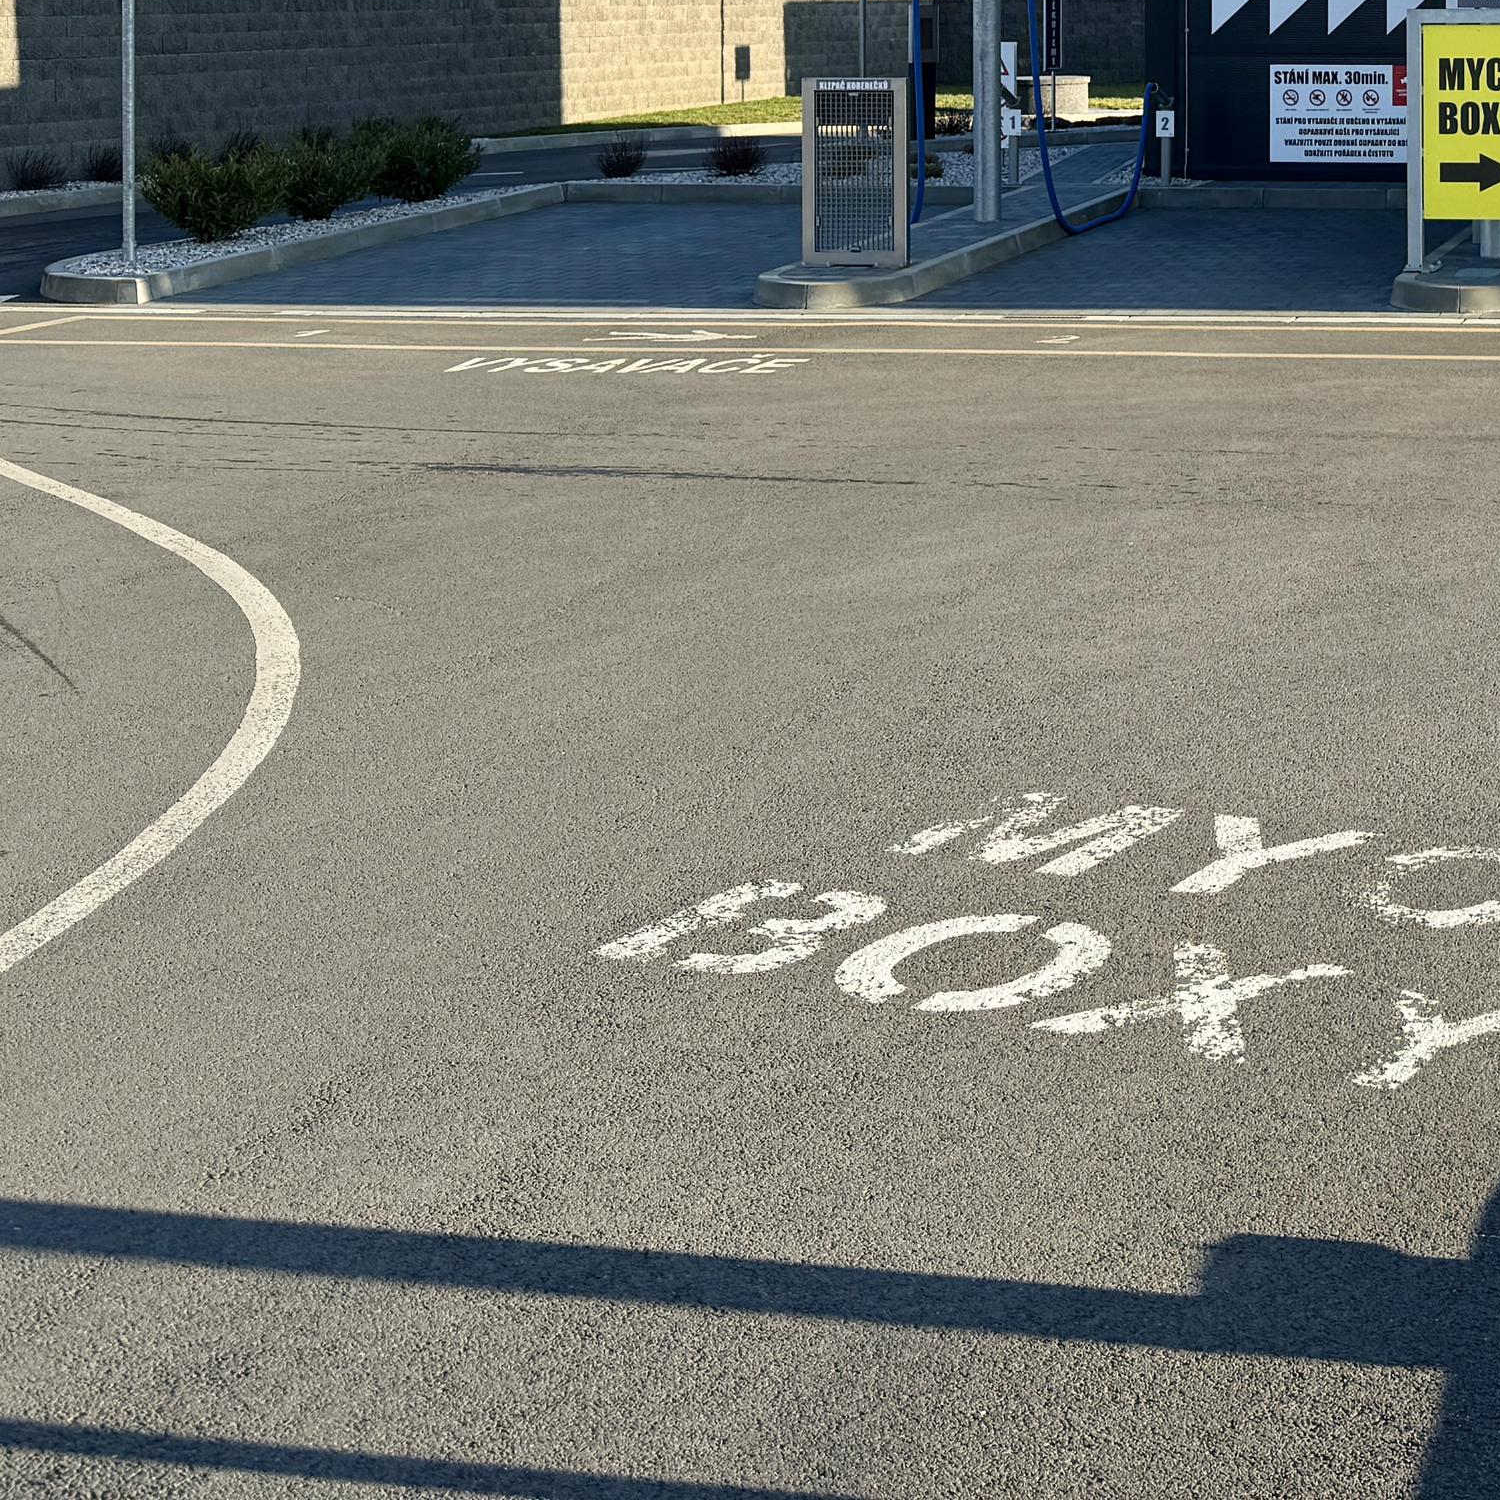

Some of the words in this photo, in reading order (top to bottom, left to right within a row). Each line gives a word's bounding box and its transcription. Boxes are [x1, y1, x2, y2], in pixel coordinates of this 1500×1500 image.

[1274, 69, 1309, 85] STÁNÍ
[1312, 71, 1342, 85] MAX.
[1345, 71, 1388, 85] 30min.
[1010, 116, 1016, 129] 1
[1161, 117, 1169, 131] 2
[443, 353, 811, 376] VYSAVAČE
